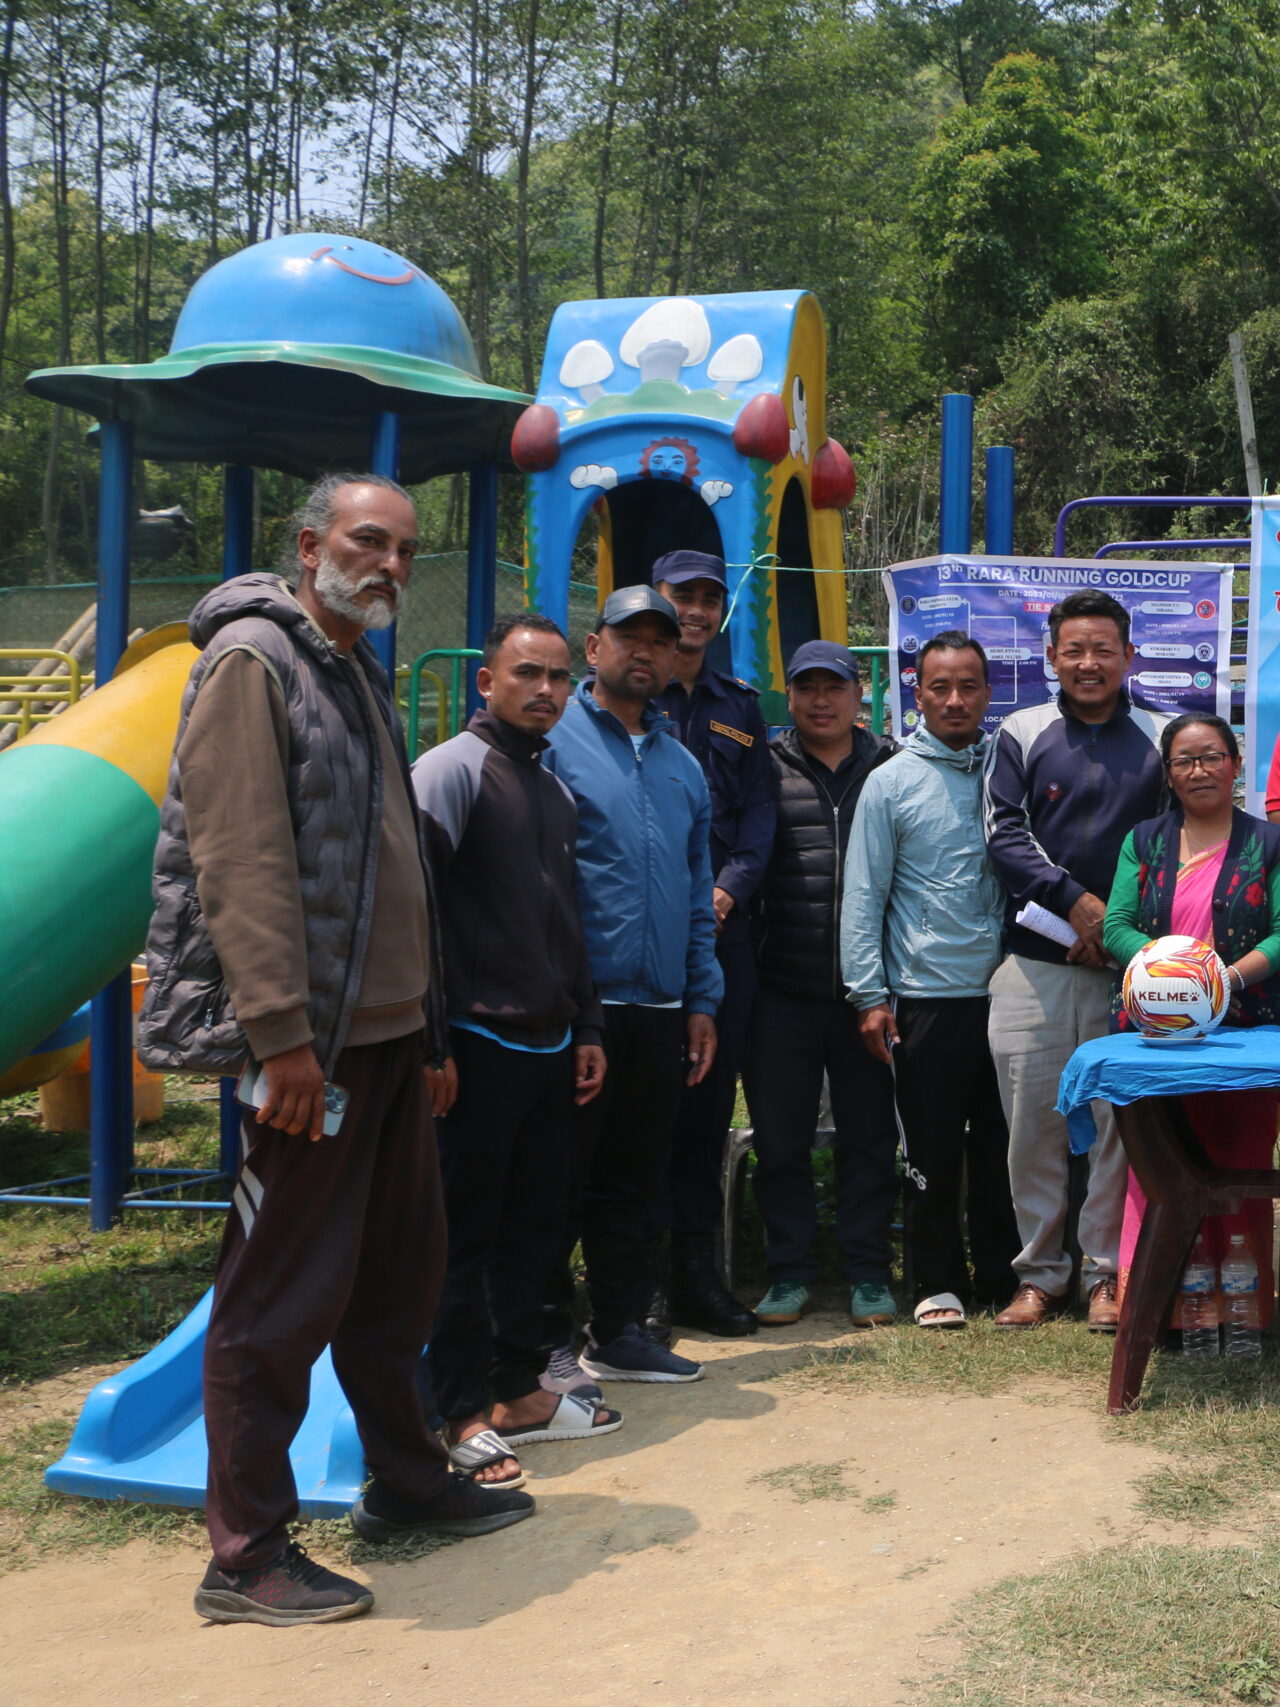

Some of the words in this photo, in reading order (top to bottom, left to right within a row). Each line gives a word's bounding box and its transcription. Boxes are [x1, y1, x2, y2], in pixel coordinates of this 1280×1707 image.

[967, 566, 1016, 582] RARA
[1019, 568, 1102, 586] RUNNING
[1105, 571, 1192, 588] GOLDCUP
[1027, 602, 1042, 611] TIE
[1138, 990, 1189, 1002] KELME
